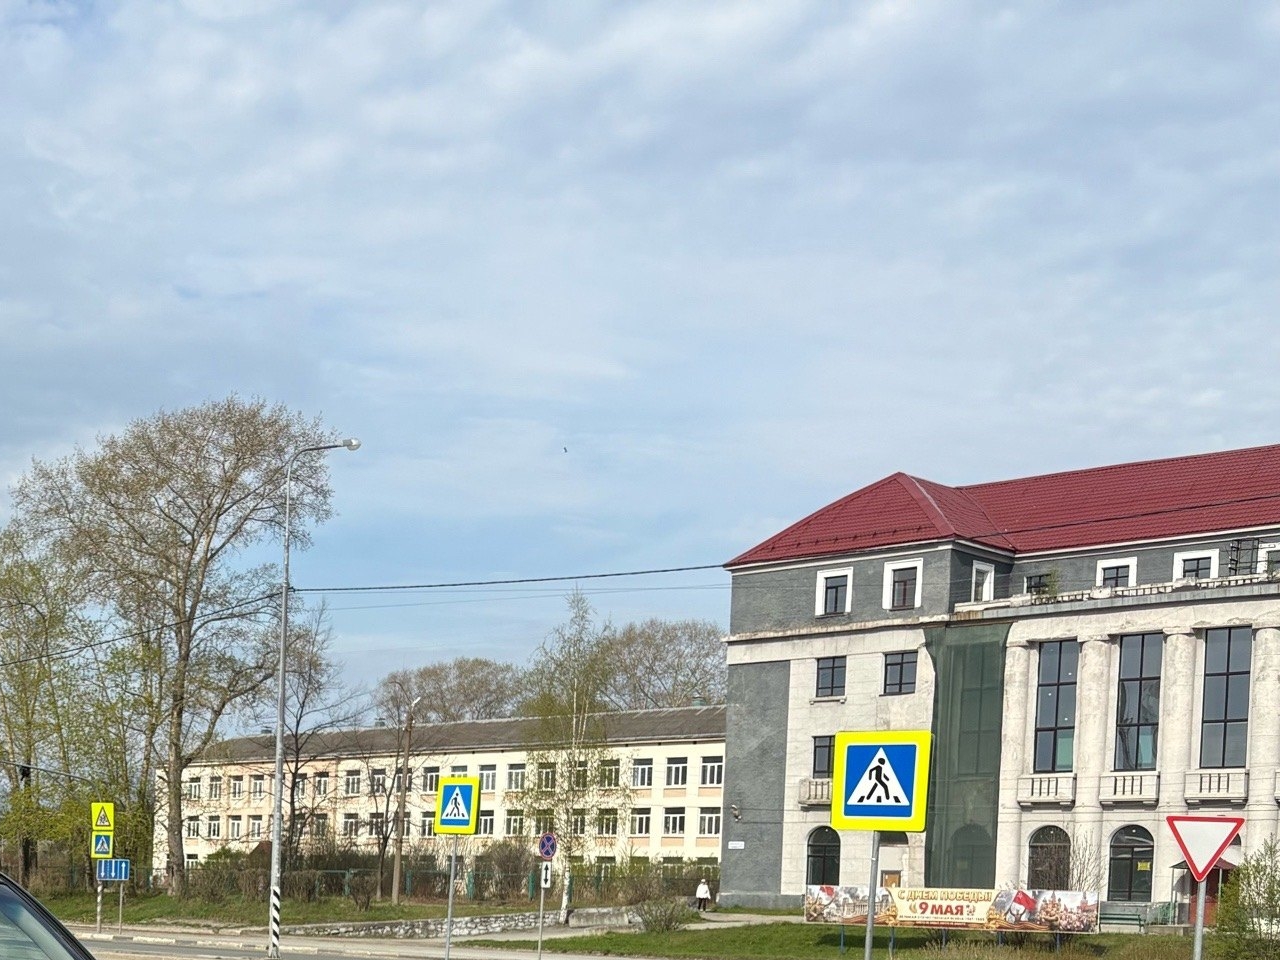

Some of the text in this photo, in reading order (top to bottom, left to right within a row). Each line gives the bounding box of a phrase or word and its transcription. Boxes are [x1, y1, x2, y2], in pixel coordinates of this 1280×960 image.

[898, 890, 905, 900] С
[918, 902, 964, 915] 9 МАЯ
